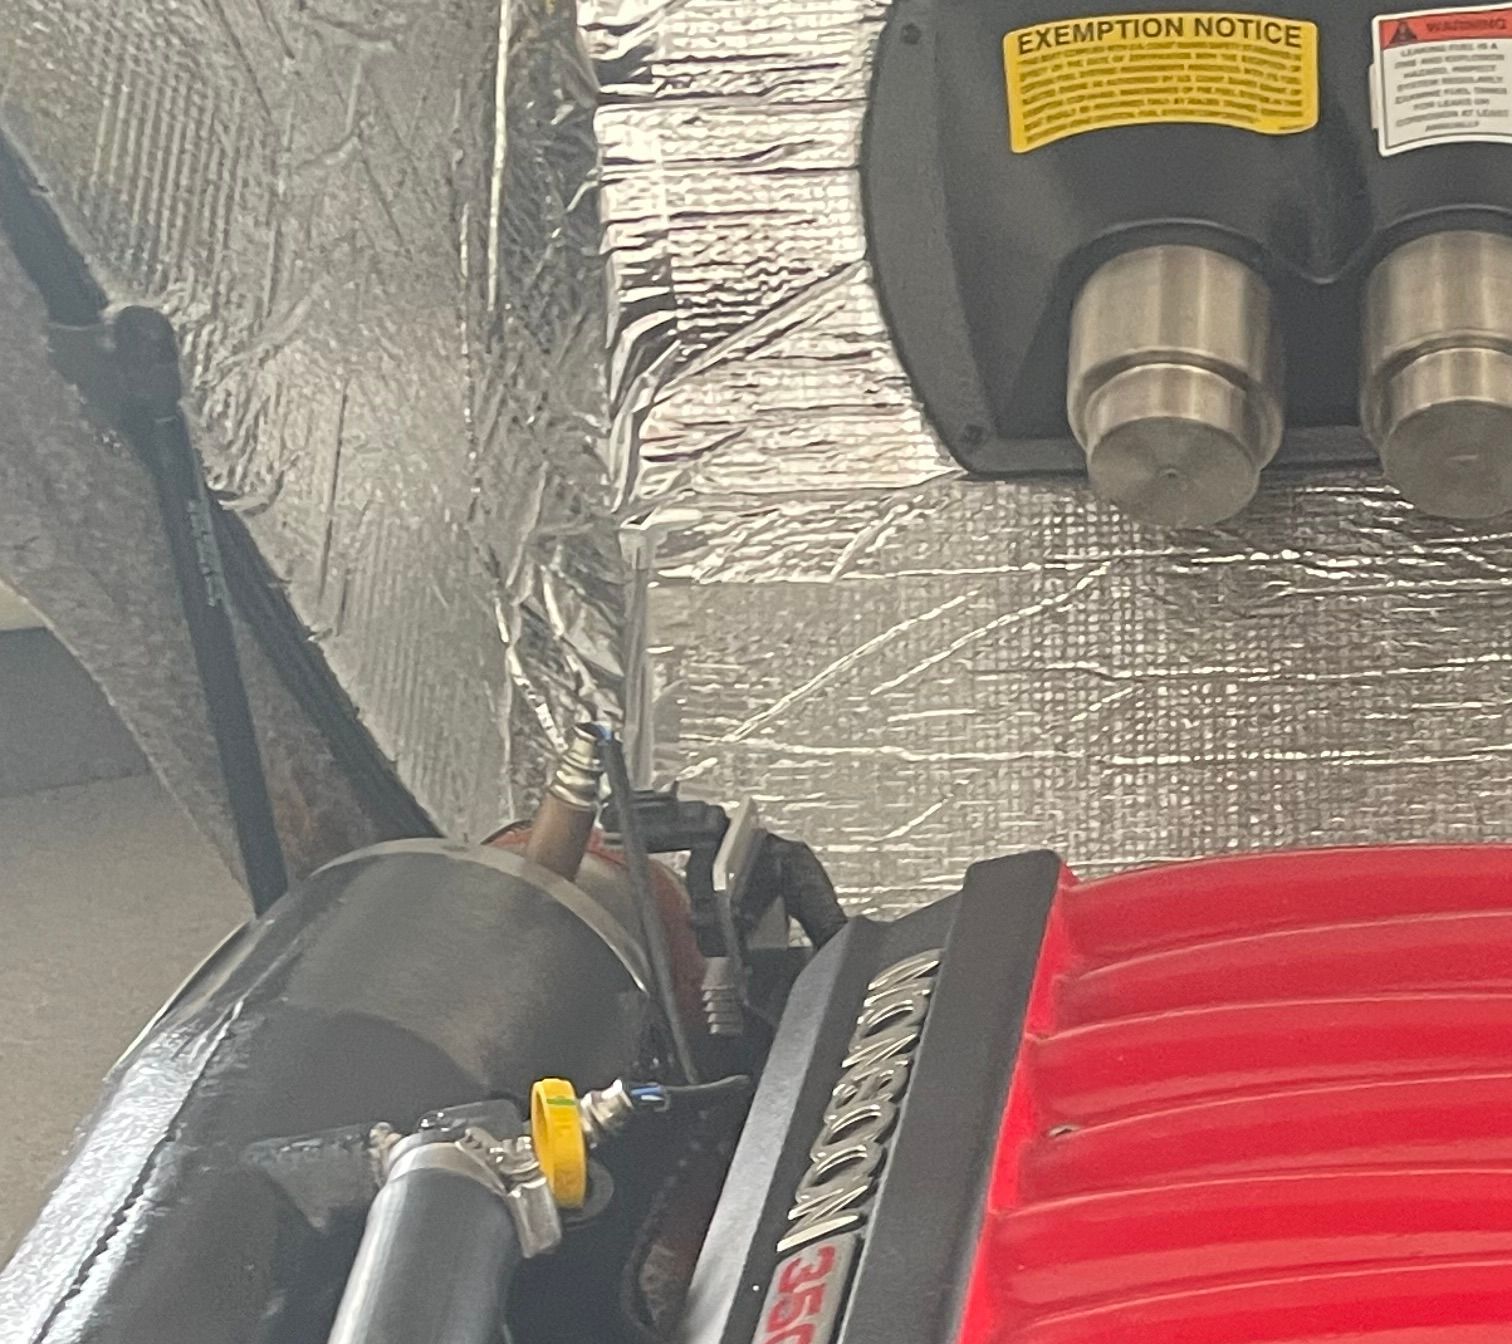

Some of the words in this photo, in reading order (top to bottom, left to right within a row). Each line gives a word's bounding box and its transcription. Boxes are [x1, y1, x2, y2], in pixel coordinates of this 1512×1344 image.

[1018, 17, 1184, 54] EXEMPTION
[1194, 16, 1301, 47] NOTICE
[776, 948, 944, 1253] MONSOON
